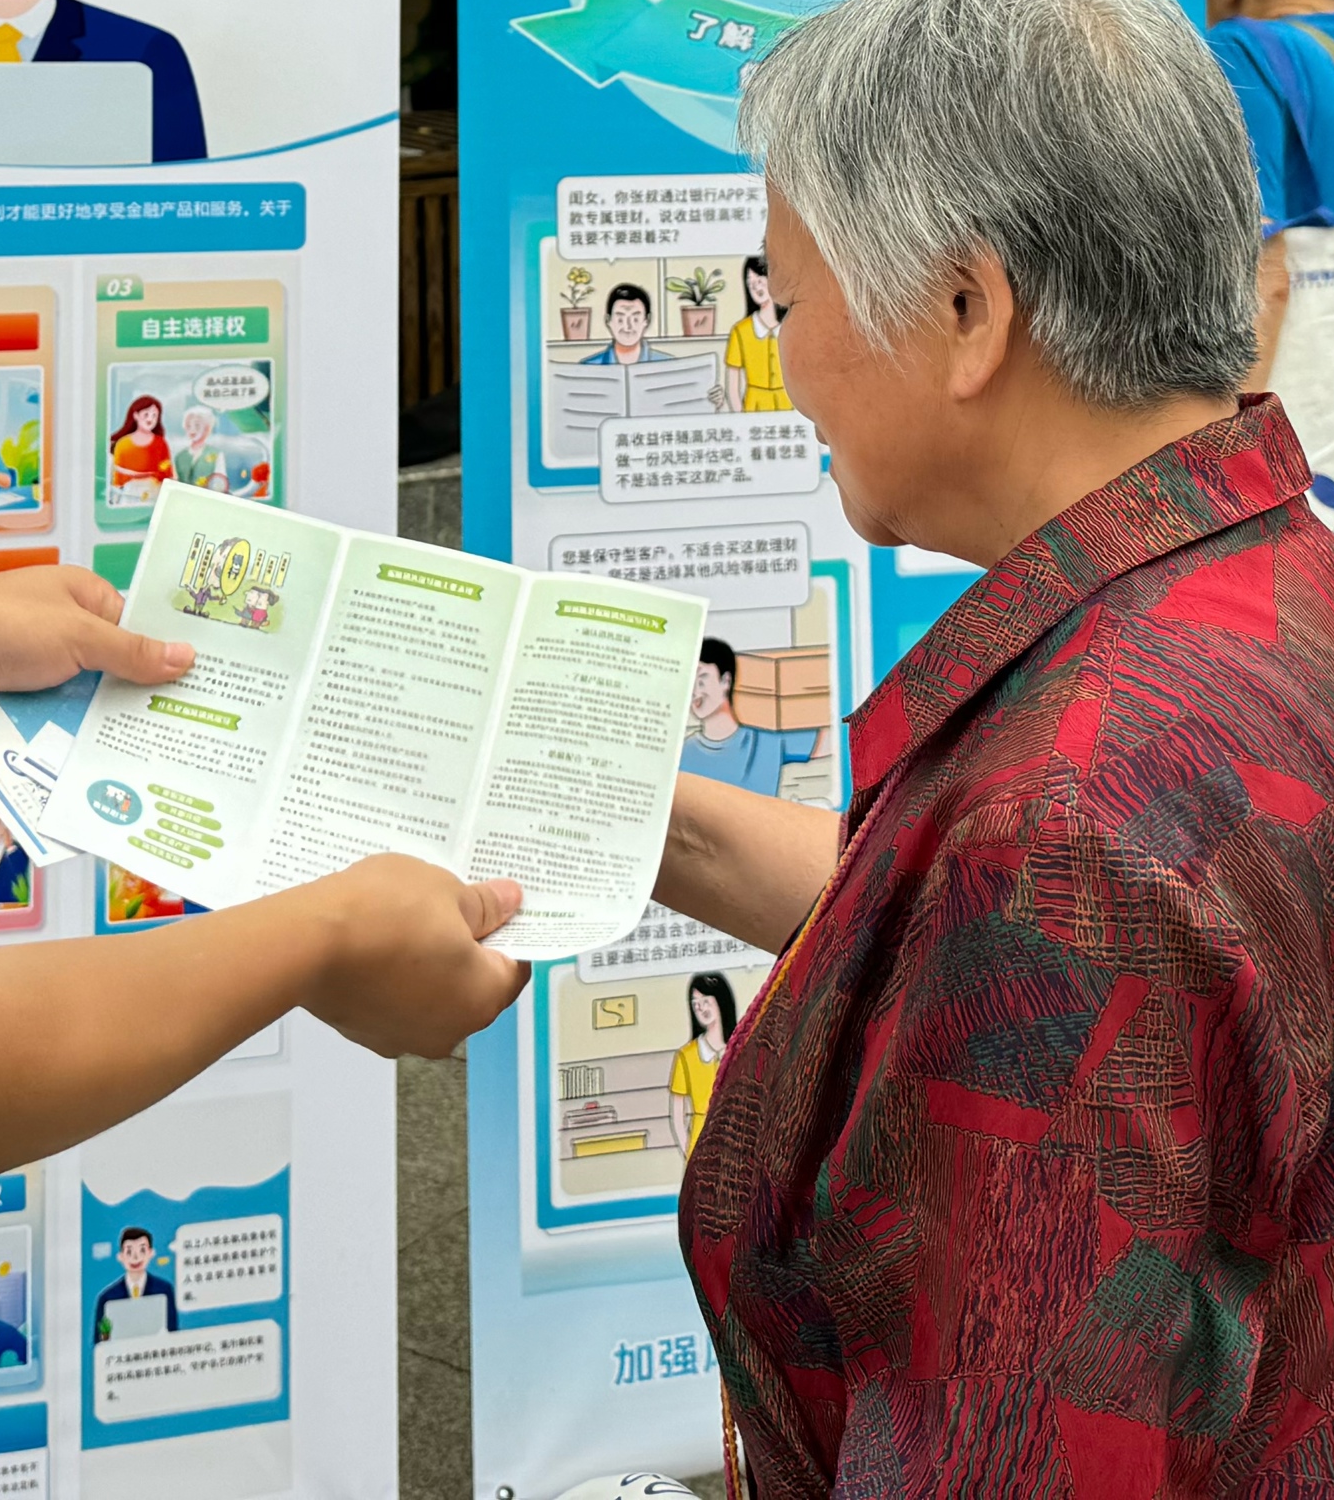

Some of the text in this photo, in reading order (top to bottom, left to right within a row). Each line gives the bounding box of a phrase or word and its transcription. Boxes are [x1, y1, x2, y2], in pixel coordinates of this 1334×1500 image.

[107, 279, 133, 297] 03
[141, 315, 247, 340] 自主选择权
[614, 1335, 720, 1385] 加强
